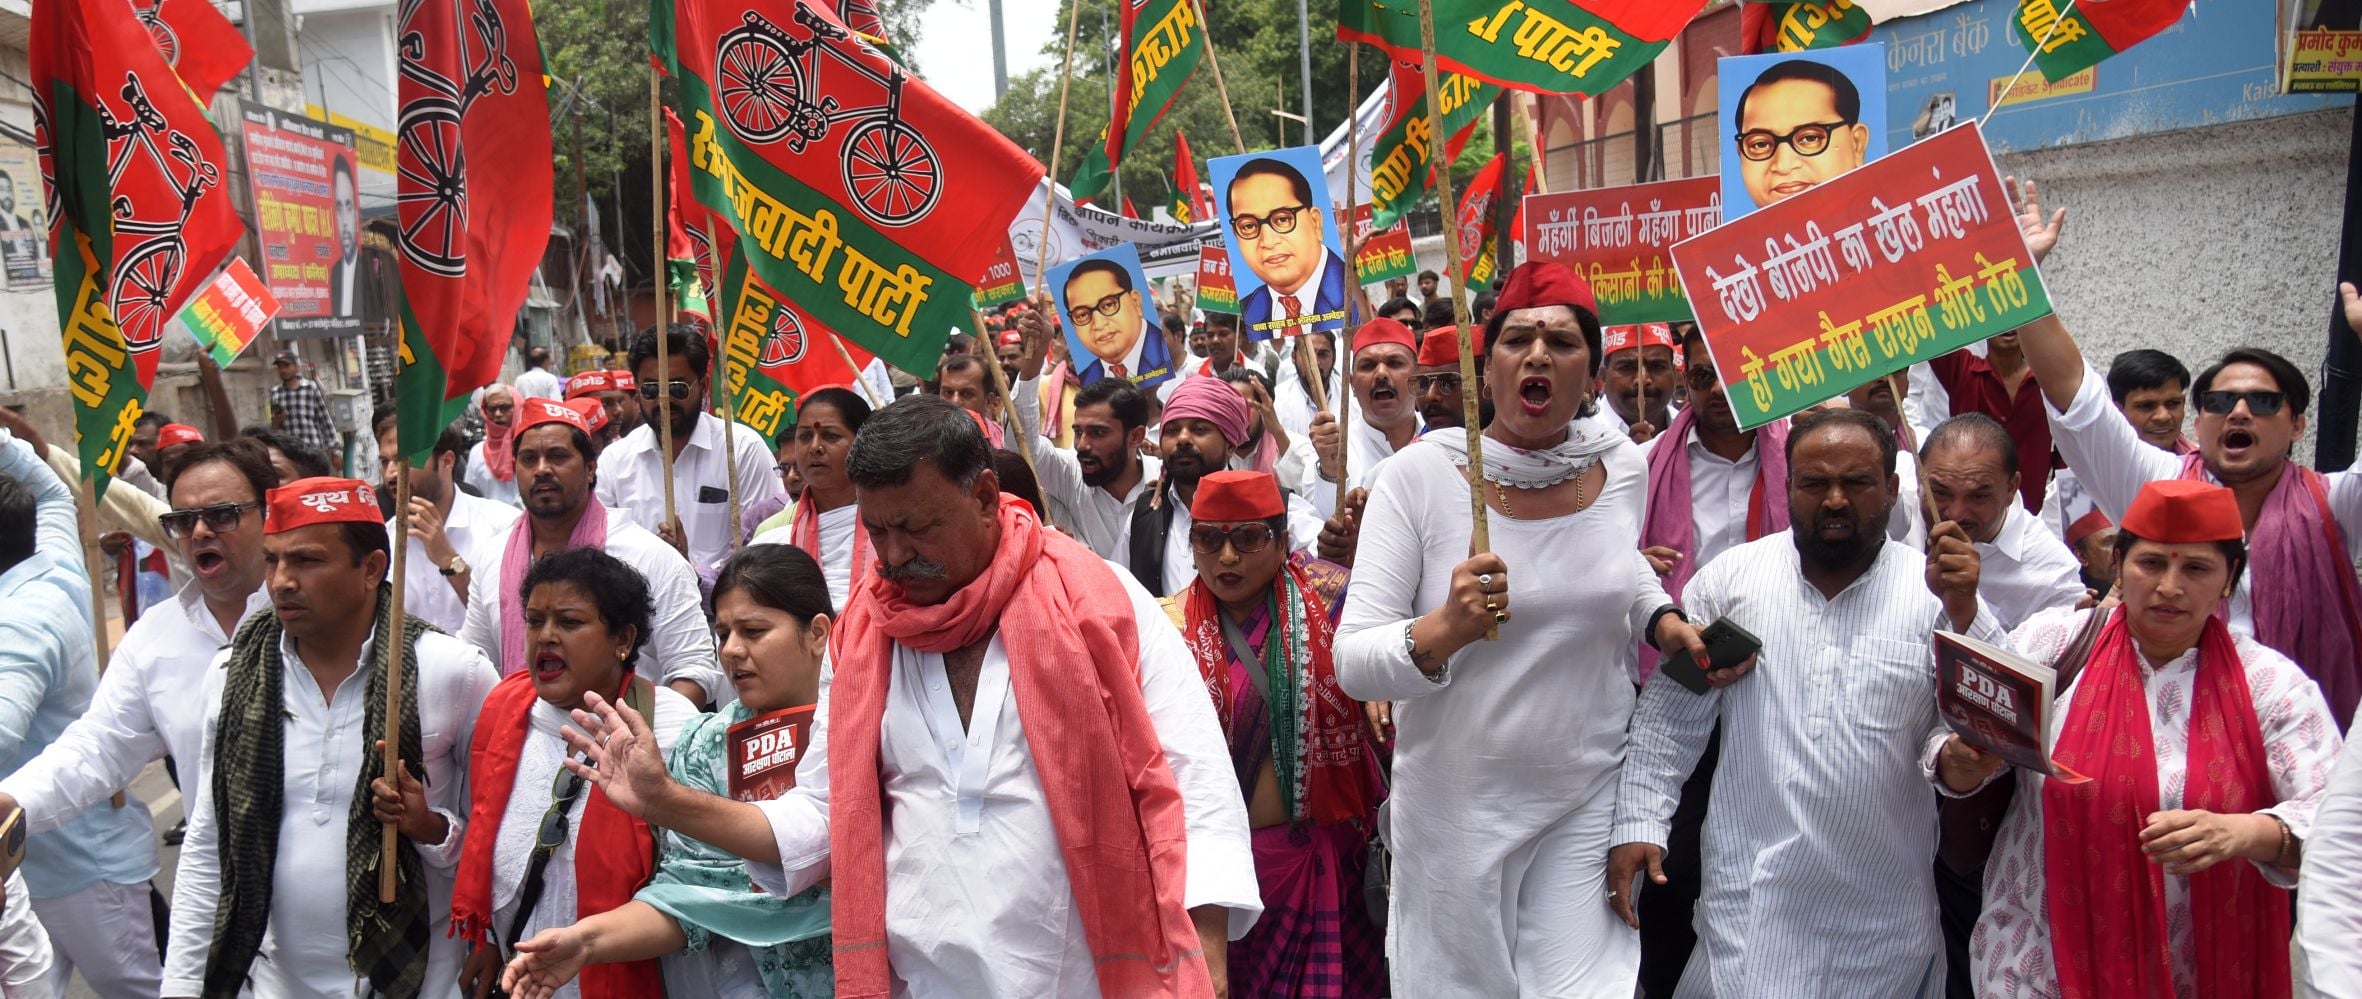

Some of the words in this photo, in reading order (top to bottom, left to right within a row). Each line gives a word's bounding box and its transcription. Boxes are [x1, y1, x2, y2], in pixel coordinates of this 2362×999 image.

[1512, 9, 1622, 78] पार्टी
[1887, 31, 1947, 73] केनरा
[1952, 12, 1990, 57] बैंक
[2336, 32, 2362, 58] कुम
[692, 108, 843, 285] समाजवादी
[837, 246, 934, 338] पार्टी
[1583, 201, 1634, 251] बिजली
[988, 262, 1012, 280] 1000
[1387, 245, 1407, 268] फेल
[1705, 253, 1767, 326] देखो
[1762, 220, 1840, 305] बीजेपी
[1834, 224, 1874, 275] का
[1868, 196, 1924, 264] खेल
[988, 282, 1018, 300] सरकार
[1589, 255, 1642, 305] किसानों
[1646, 255, 1665, 301] की
[1740, 345, 1775, 413] हो
[1769, 331, 1826, 395] गया
[1819, 310, 1873, 374] गैस
[1865, 293, 1937, 359] राशन
[1933, 263, 1988, 331] और
[1972, 250, 2029, 317] तेल
[298, 490, 351, 513] यूथ
[1956, 682, 1990, 710] आरक्षण
[1961, 665, 2014, 710] PDA
[746, 728, 793, 761] PDA
[742, 753, 771, 776] आरक्षण
